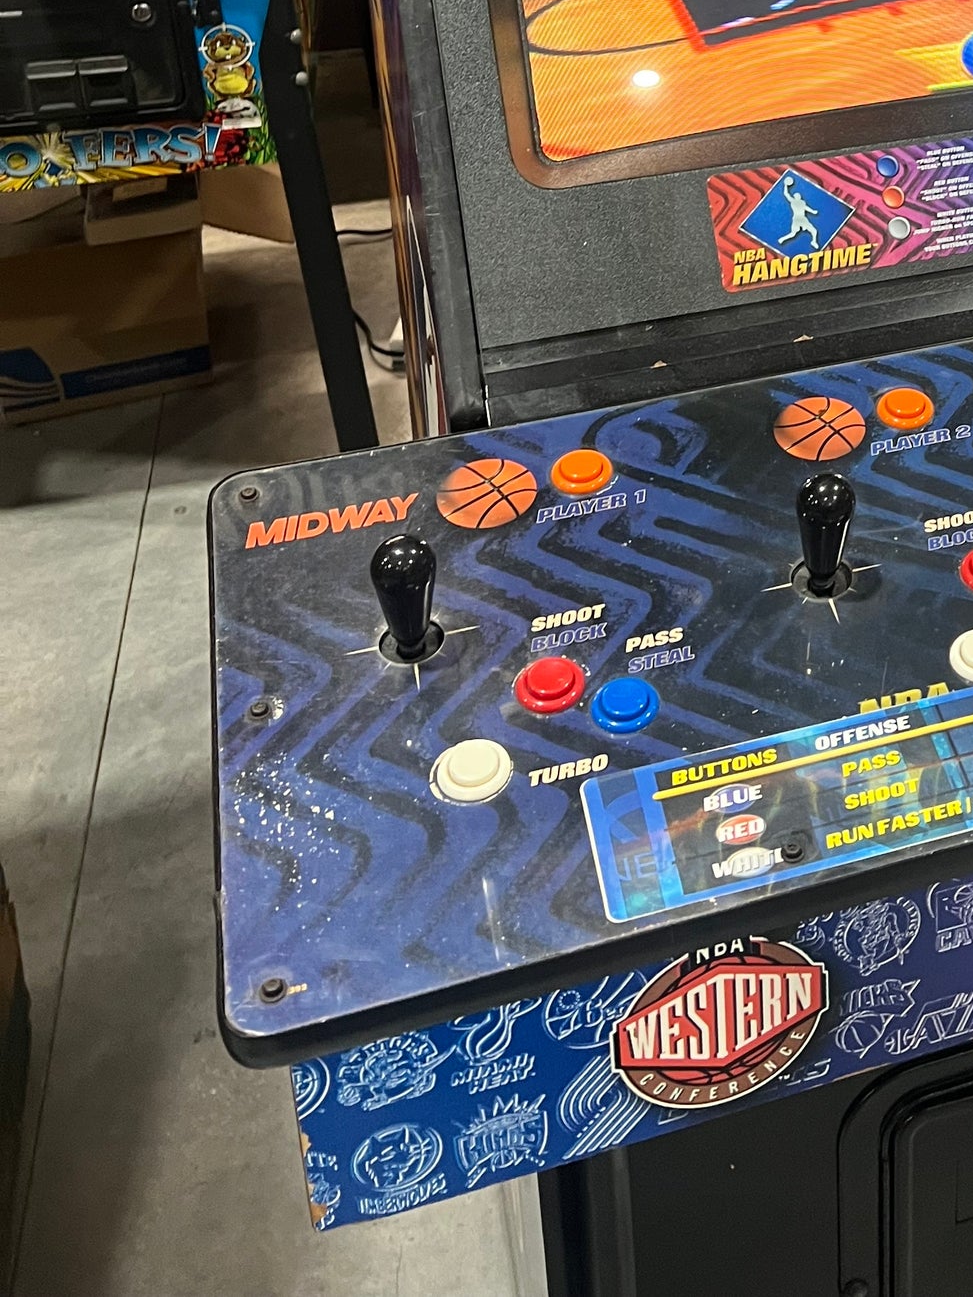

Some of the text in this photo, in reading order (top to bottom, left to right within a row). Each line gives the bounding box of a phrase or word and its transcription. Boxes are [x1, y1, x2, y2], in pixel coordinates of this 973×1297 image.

[731, 243, 873, 286] HANGTIME
[733, 248, 767, 267] NBA
[870, 424, 972, 456] PLAYER 2
[244, 492, 419, 550] MIDWAY
[536, 489, 647, 523] PLAYER 1
[531, 603, 607, 633] SHOOT
[530, 622, 608, 653] BLOCK
[625, 627, 685, 653] PASS
[627, 646, 695, 674] STEAL
[814, 714, 912, 752] OFFENSE
[528, 753, 610, 787] TURBO
[671, 748, 778, 787] BUTTONS
[841, 749, 902, 778] PASS
[703, 784, 764, 813] BLUE
[844, 778, 920, 811] SHOOT
[716, 818, 766, 844] RED
[825, 821, 876, 850] RUN
[876, 798, 964, 837] FASTER
[625, 972, 813, 1060] WESTERN
[639, 1030, 805, 1102] CONFERENCE
